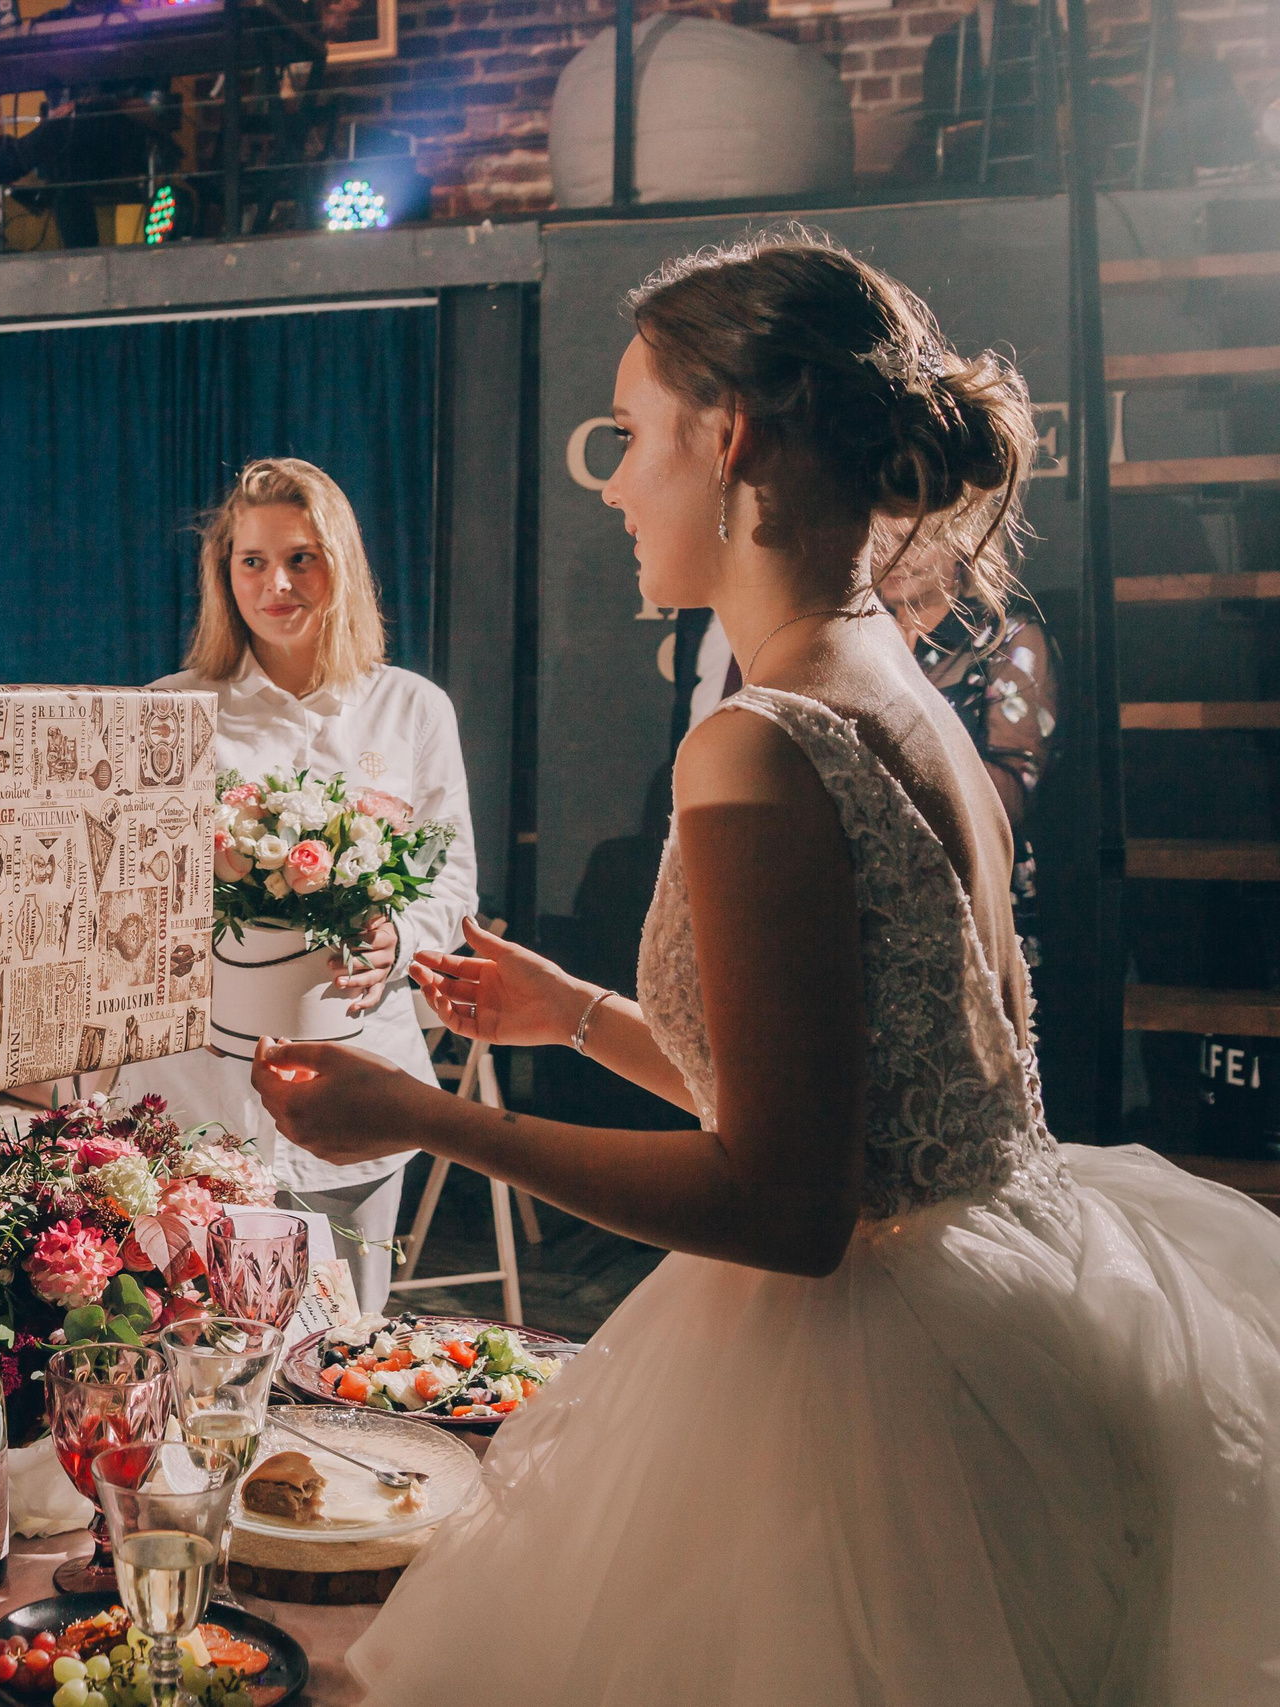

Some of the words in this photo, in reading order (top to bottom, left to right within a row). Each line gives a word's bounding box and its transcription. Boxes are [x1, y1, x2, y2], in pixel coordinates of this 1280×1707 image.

[37, 705, 87, 718] RETRO
[114, 696, 124, 783] GENTLEMAN
[14, 704, 25, 777] MISTER
[21, 810, 77, 827] GENTLEMAN
[163, 808, 184, 816] Vintage
[13, 835, 21, 894] RETRO
[128, 818, 137, 887] MILORD
[77, 861, 87, 953] ARISTOCRAT
[158, 886, 168, 940] RETRO
[157, 944, 166, 1005] VOYAGE
[96, 992, 155, 1016] ARISTOCRAT
[8, 1032, 21, 1088] NEWS
